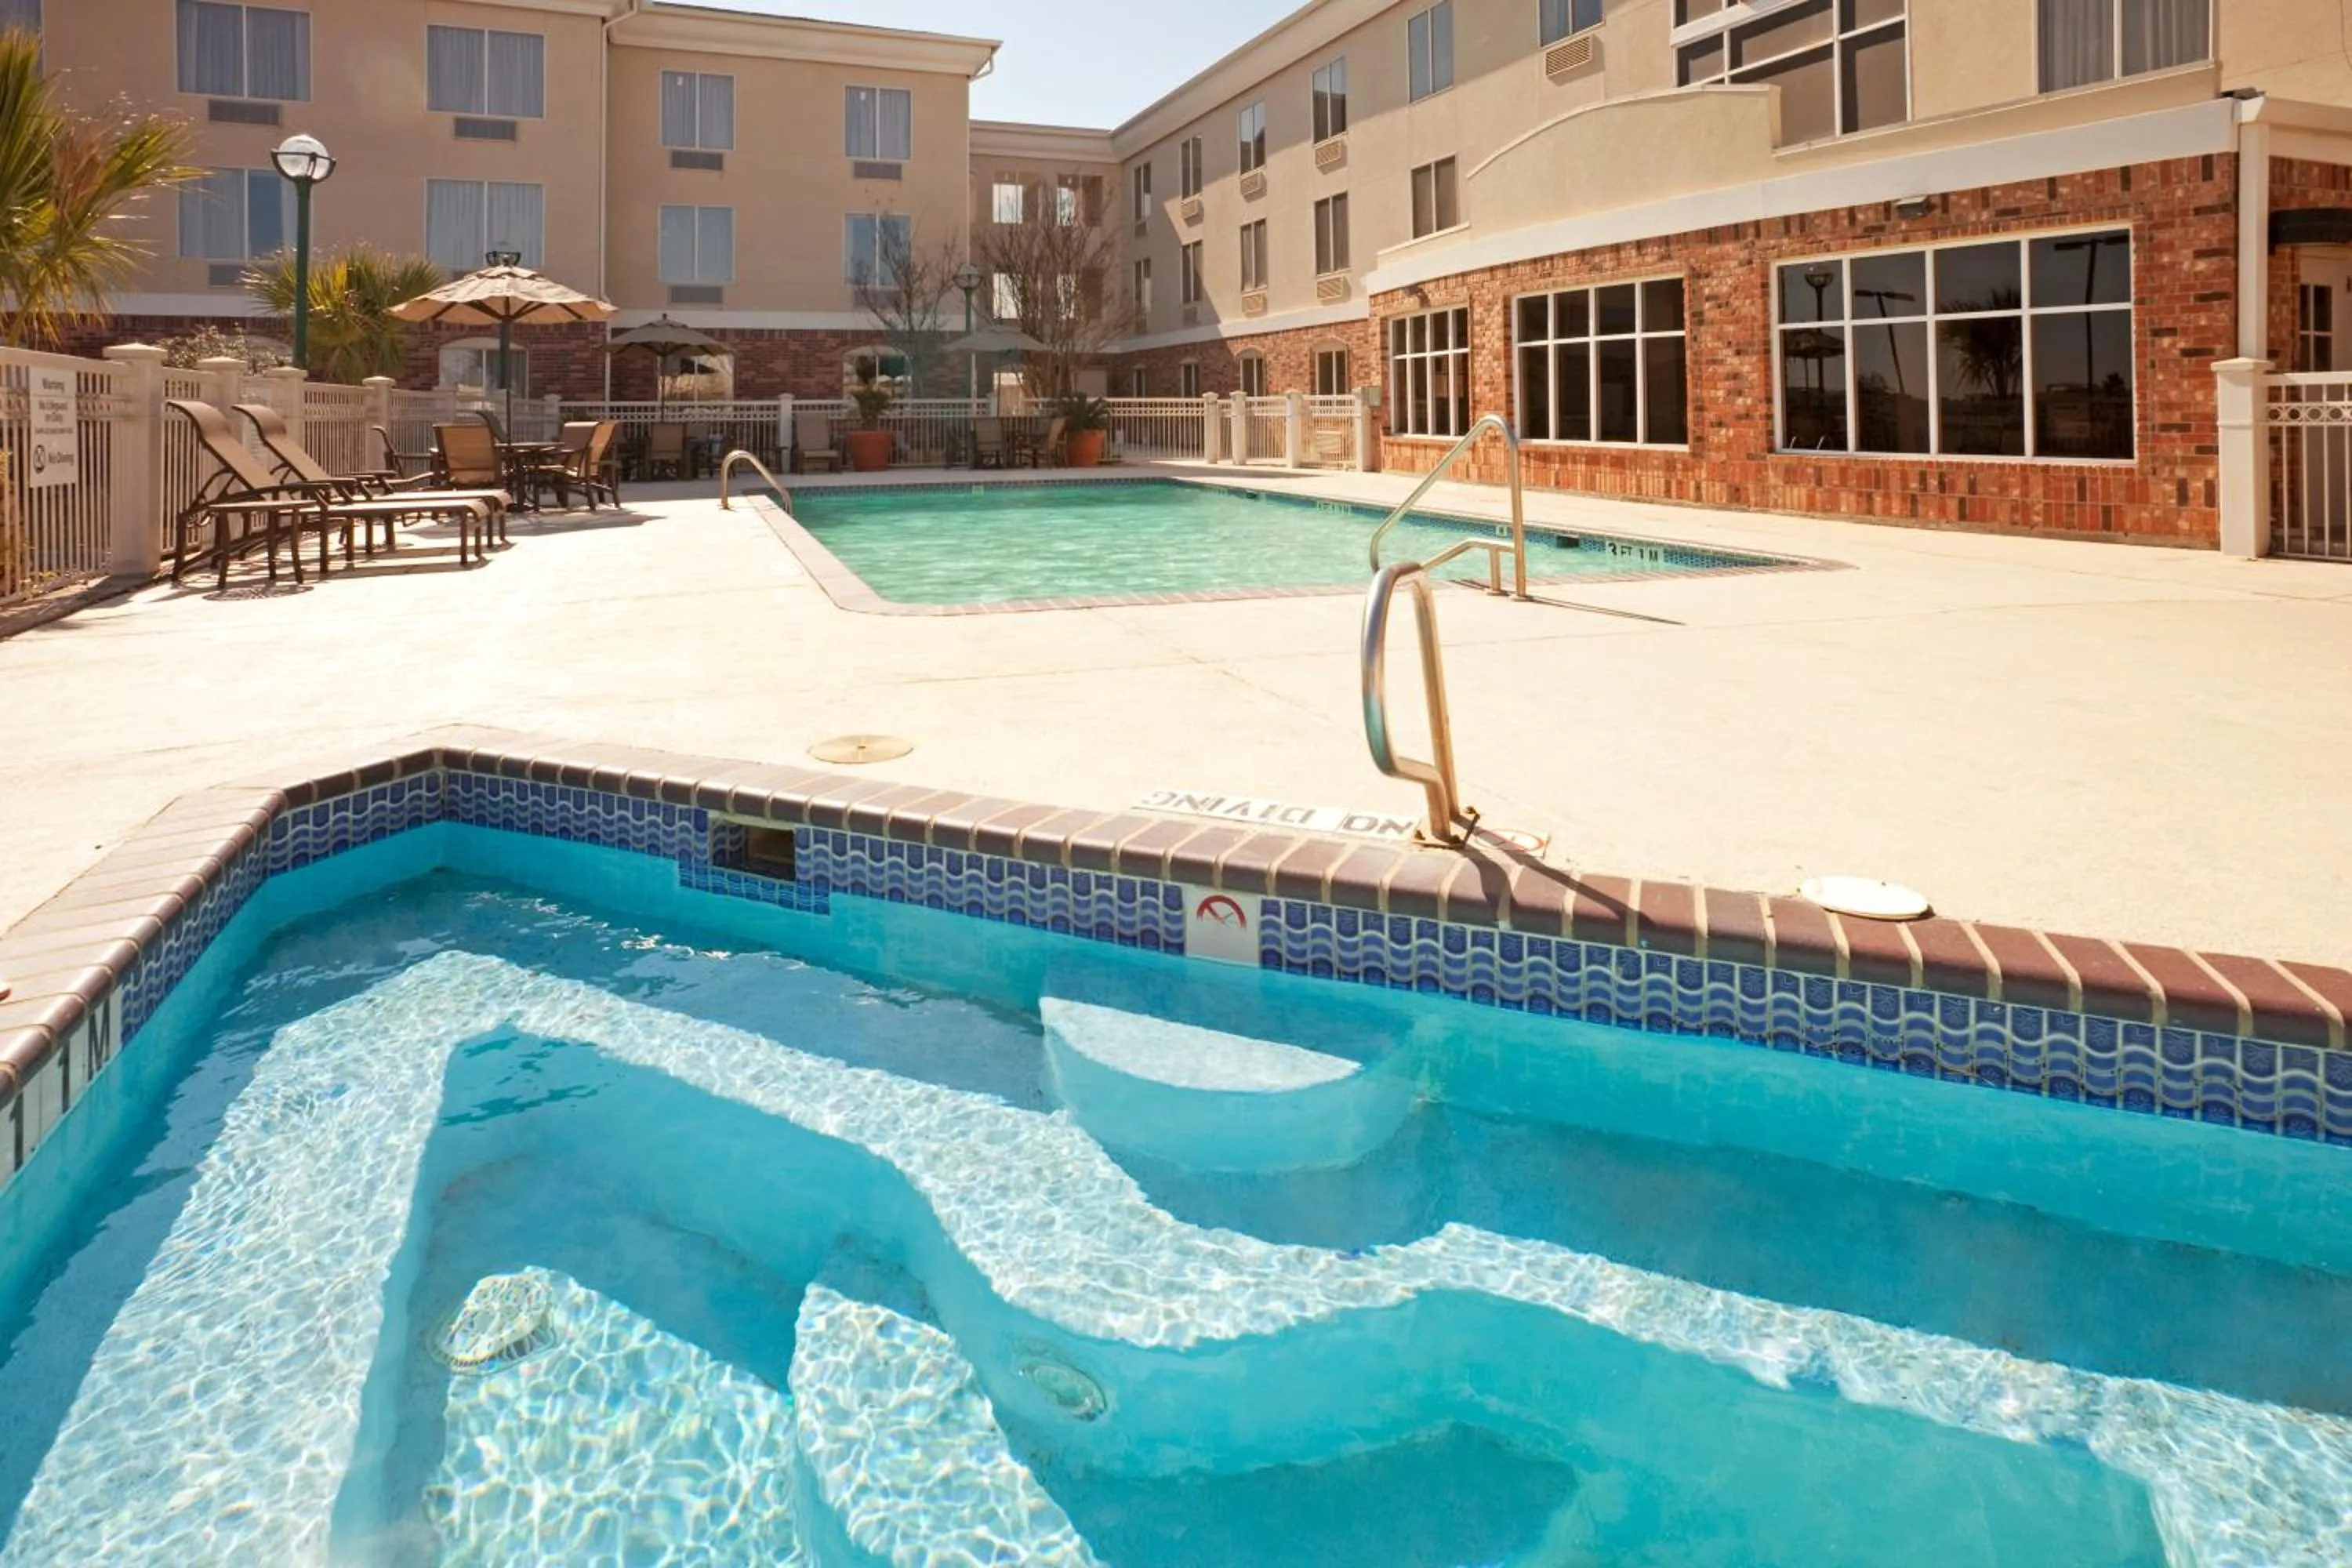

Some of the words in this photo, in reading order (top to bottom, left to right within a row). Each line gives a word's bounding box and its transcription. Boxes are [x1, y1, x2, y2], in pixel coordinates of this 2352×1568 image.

[1621, 545, 1632, 557] FT
[1141, 790, 1319, 824] DIVING
[1341, 815, 1414, 836] NO
